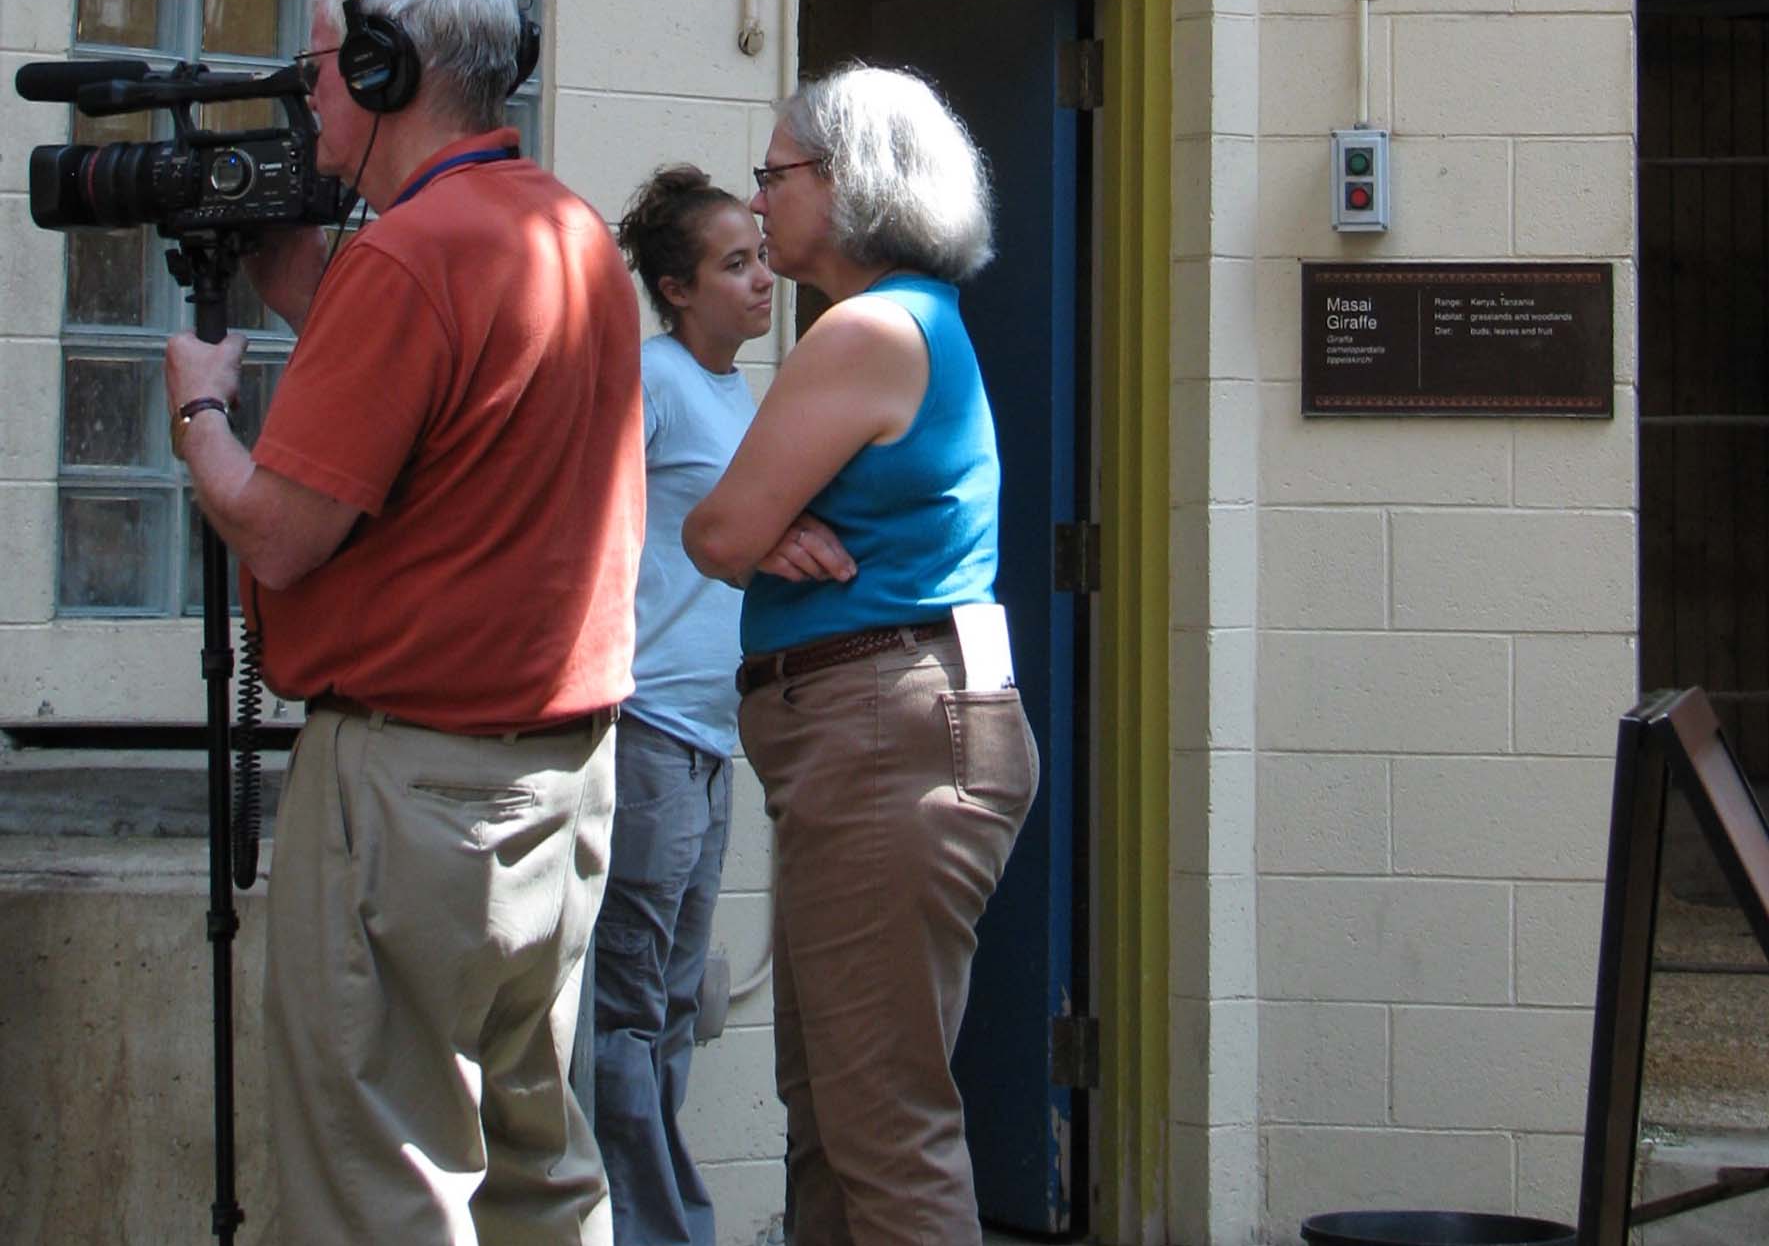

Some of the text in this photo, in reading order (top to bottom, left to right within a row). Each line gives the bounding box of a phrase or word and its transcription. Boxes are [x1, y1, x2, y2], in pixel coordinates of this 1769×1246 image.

[1326, 297, 1372, 312] Masai
[1434, 297, 1463, 307] Range:
[1500, 297, 1535, 306] Tanzania
[1514, 312, 1530, 321] and
[1531, 312, 1573, 321] woodlands
[1326, 314, 1378, 330] Giraffe
[1494, 327, 1520, 336] leaves
[1521, 326, 1537, 336] and
[1538, 326, 1553, 336] fruit
